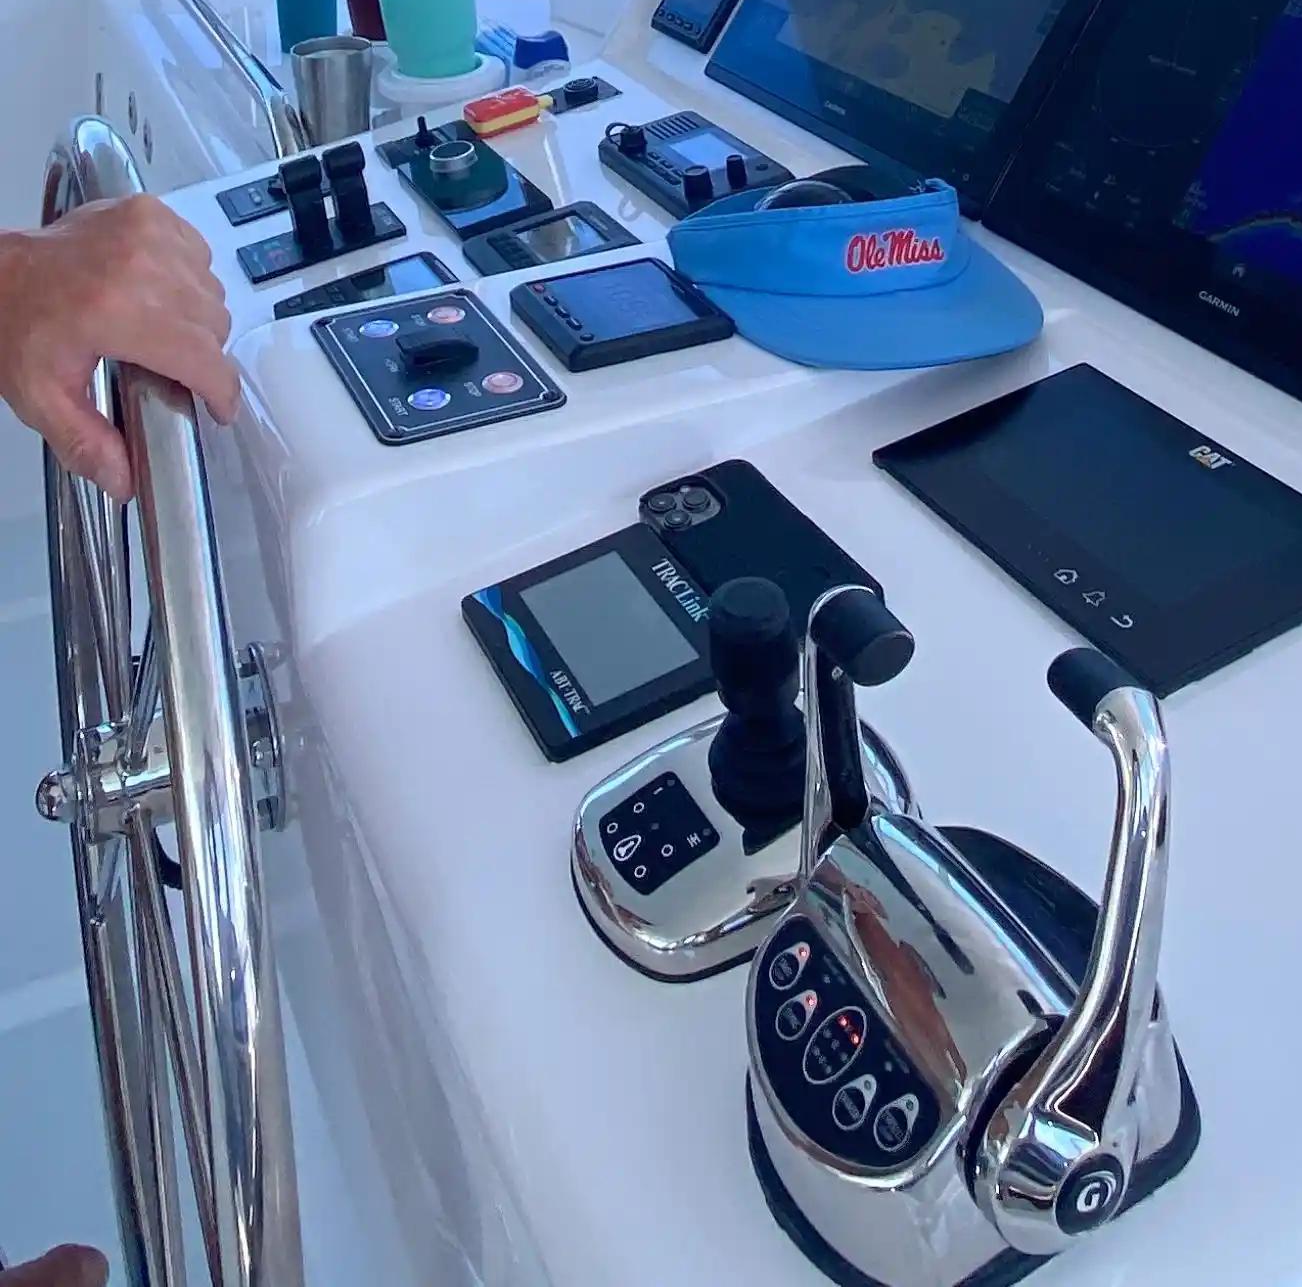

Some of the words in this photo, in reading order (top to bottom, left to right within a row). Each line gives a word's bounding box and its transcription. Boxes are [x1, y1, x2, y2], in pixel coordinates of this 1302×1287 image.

[845, 234, 886, 274] Ole
[882, 228, 945, 267] Miss
[1198, 290, 1240, 317] GARMIN
[1188, 445, 1233, 470] CAT
